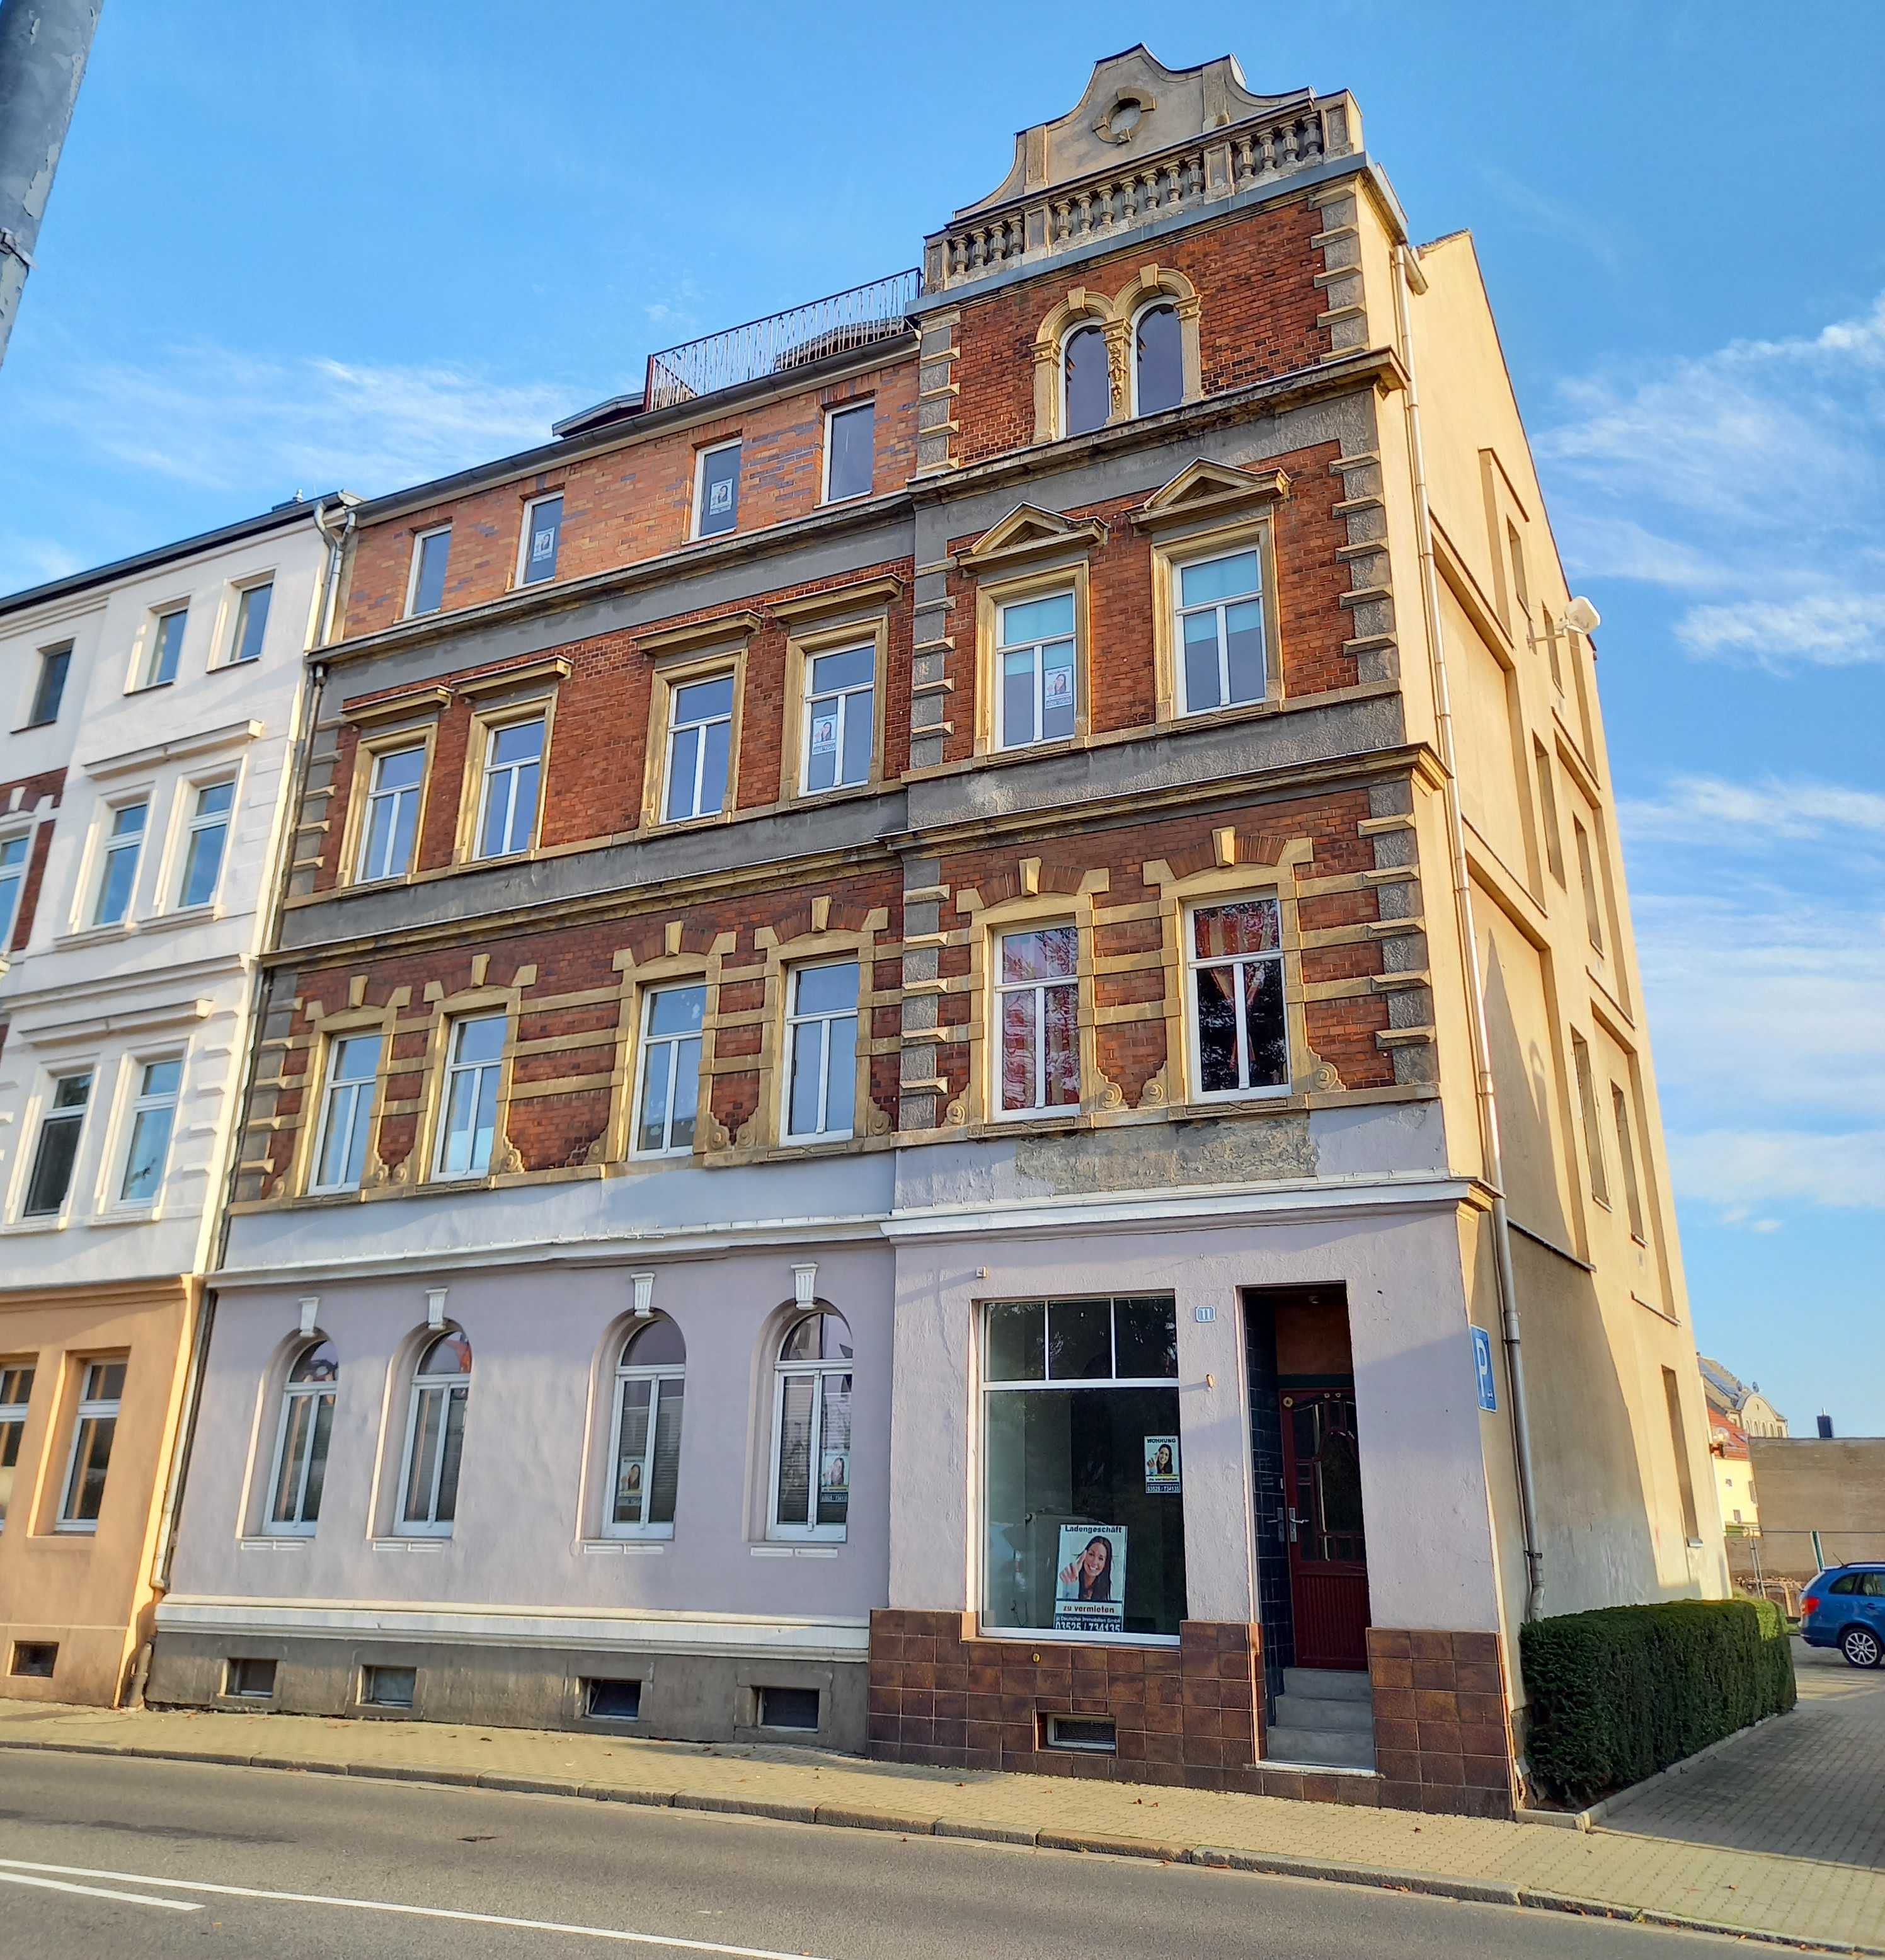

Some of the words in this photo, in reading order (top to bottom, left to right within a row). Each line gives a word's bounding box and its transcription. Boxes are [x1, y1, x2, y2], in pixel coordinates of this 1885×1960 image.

[1475, 1338, 1488, 1398] P
[1065, 1525, 1121, 1534] Ladengeschäft
[1074, 1605, 1114, 1613] vermieten
